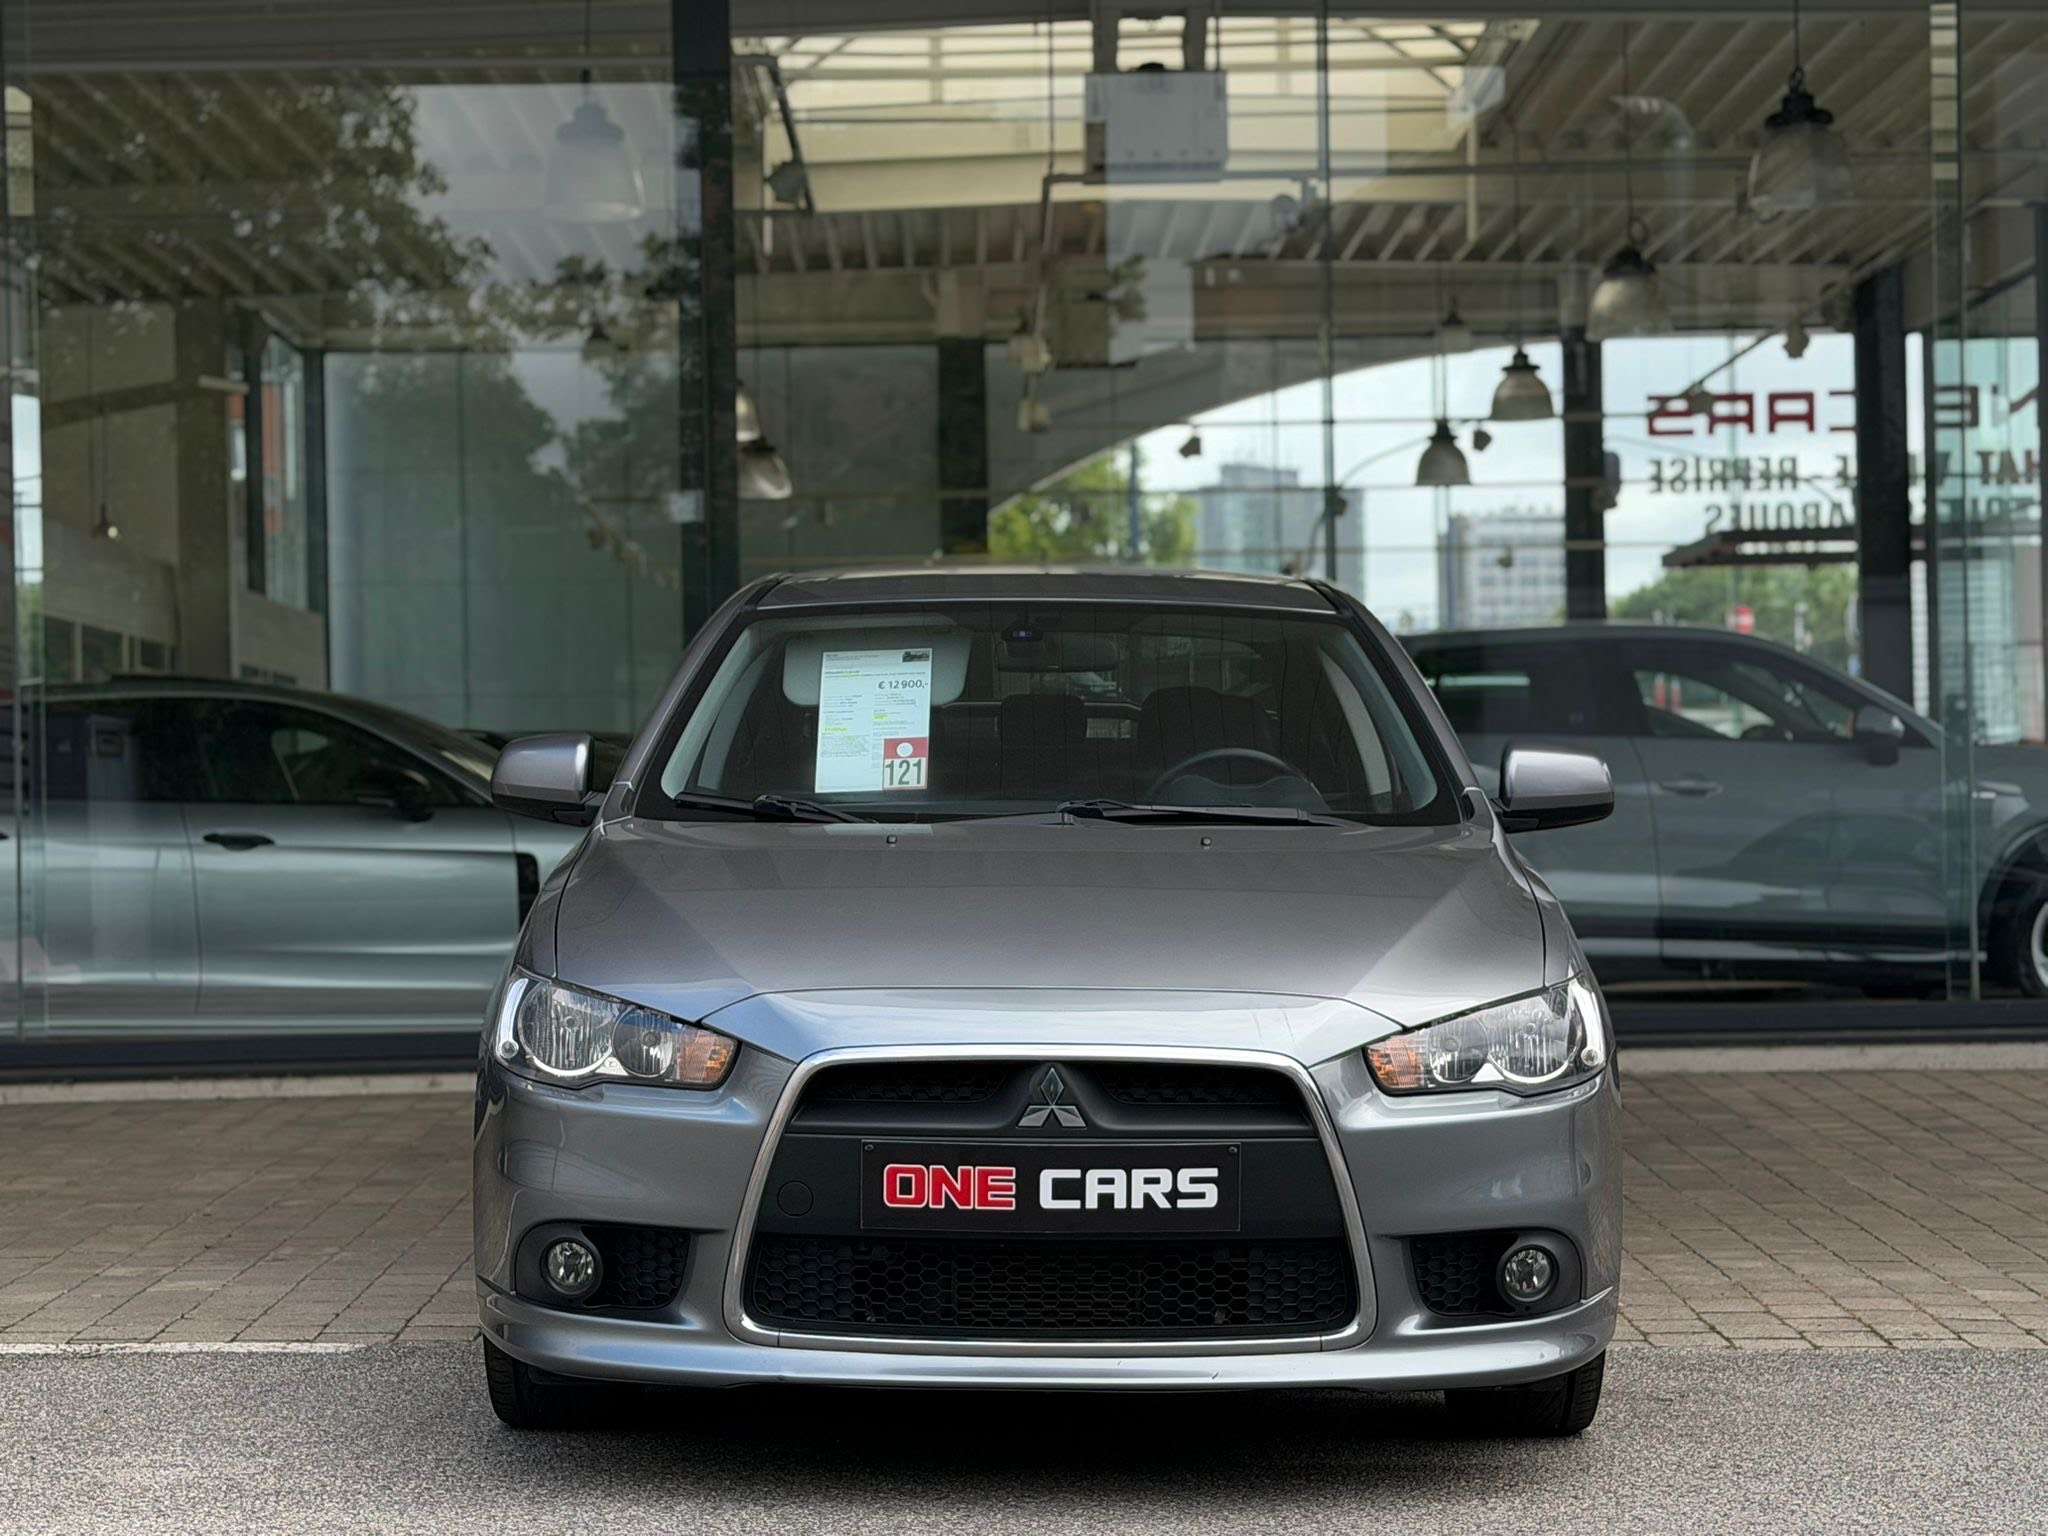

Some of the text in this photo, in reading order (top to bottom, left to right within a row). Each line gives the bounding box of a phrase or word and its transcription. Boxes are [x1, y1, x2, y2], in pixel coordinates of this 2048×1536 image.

[885, 759, 922, 786] 121
[883, 1164, 1219, 1211] ONE CARS
